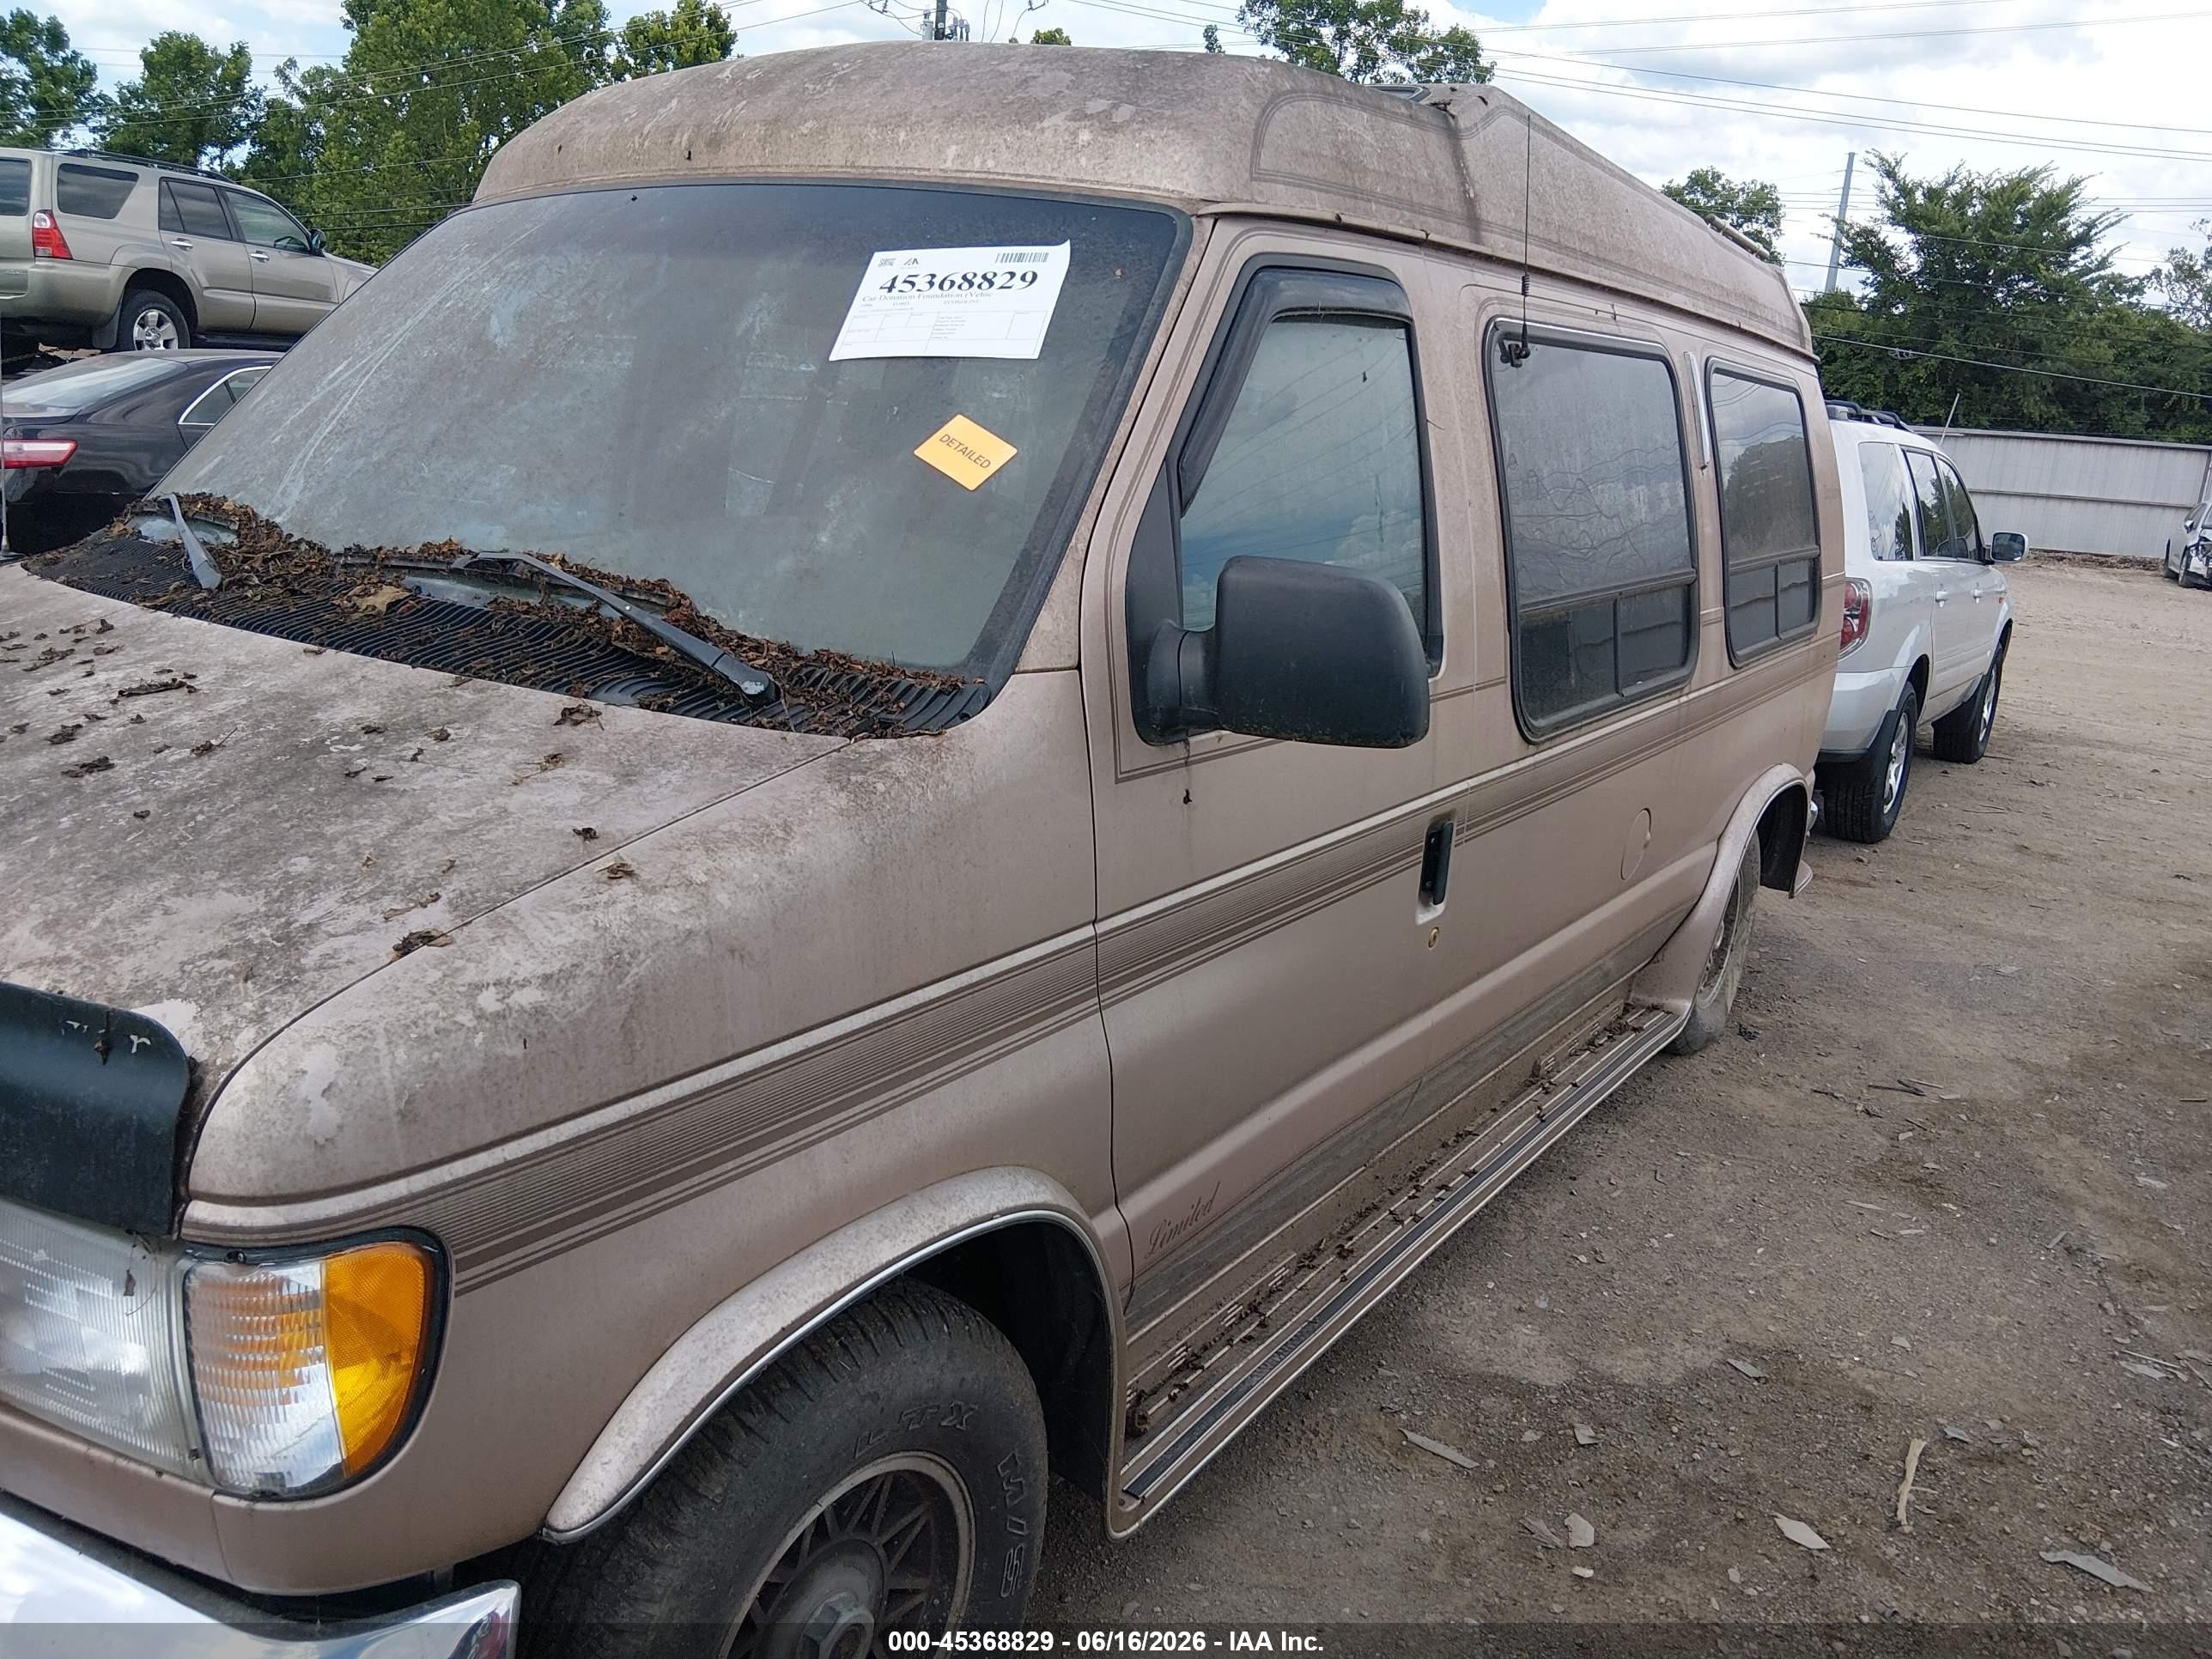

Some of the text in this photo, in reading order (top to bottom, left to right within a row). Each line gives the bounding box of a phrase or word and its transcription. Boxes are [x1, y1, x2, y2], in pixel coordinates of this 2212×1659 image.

[878, 270, 1038, 293] 45368829
[917, 292, 963, 301] Foundation
[939, 434, 991, 469] DETAILED
[1144, 1181, 1220, 1259] Limited
[854, 1401, 979, 1459] LTX
